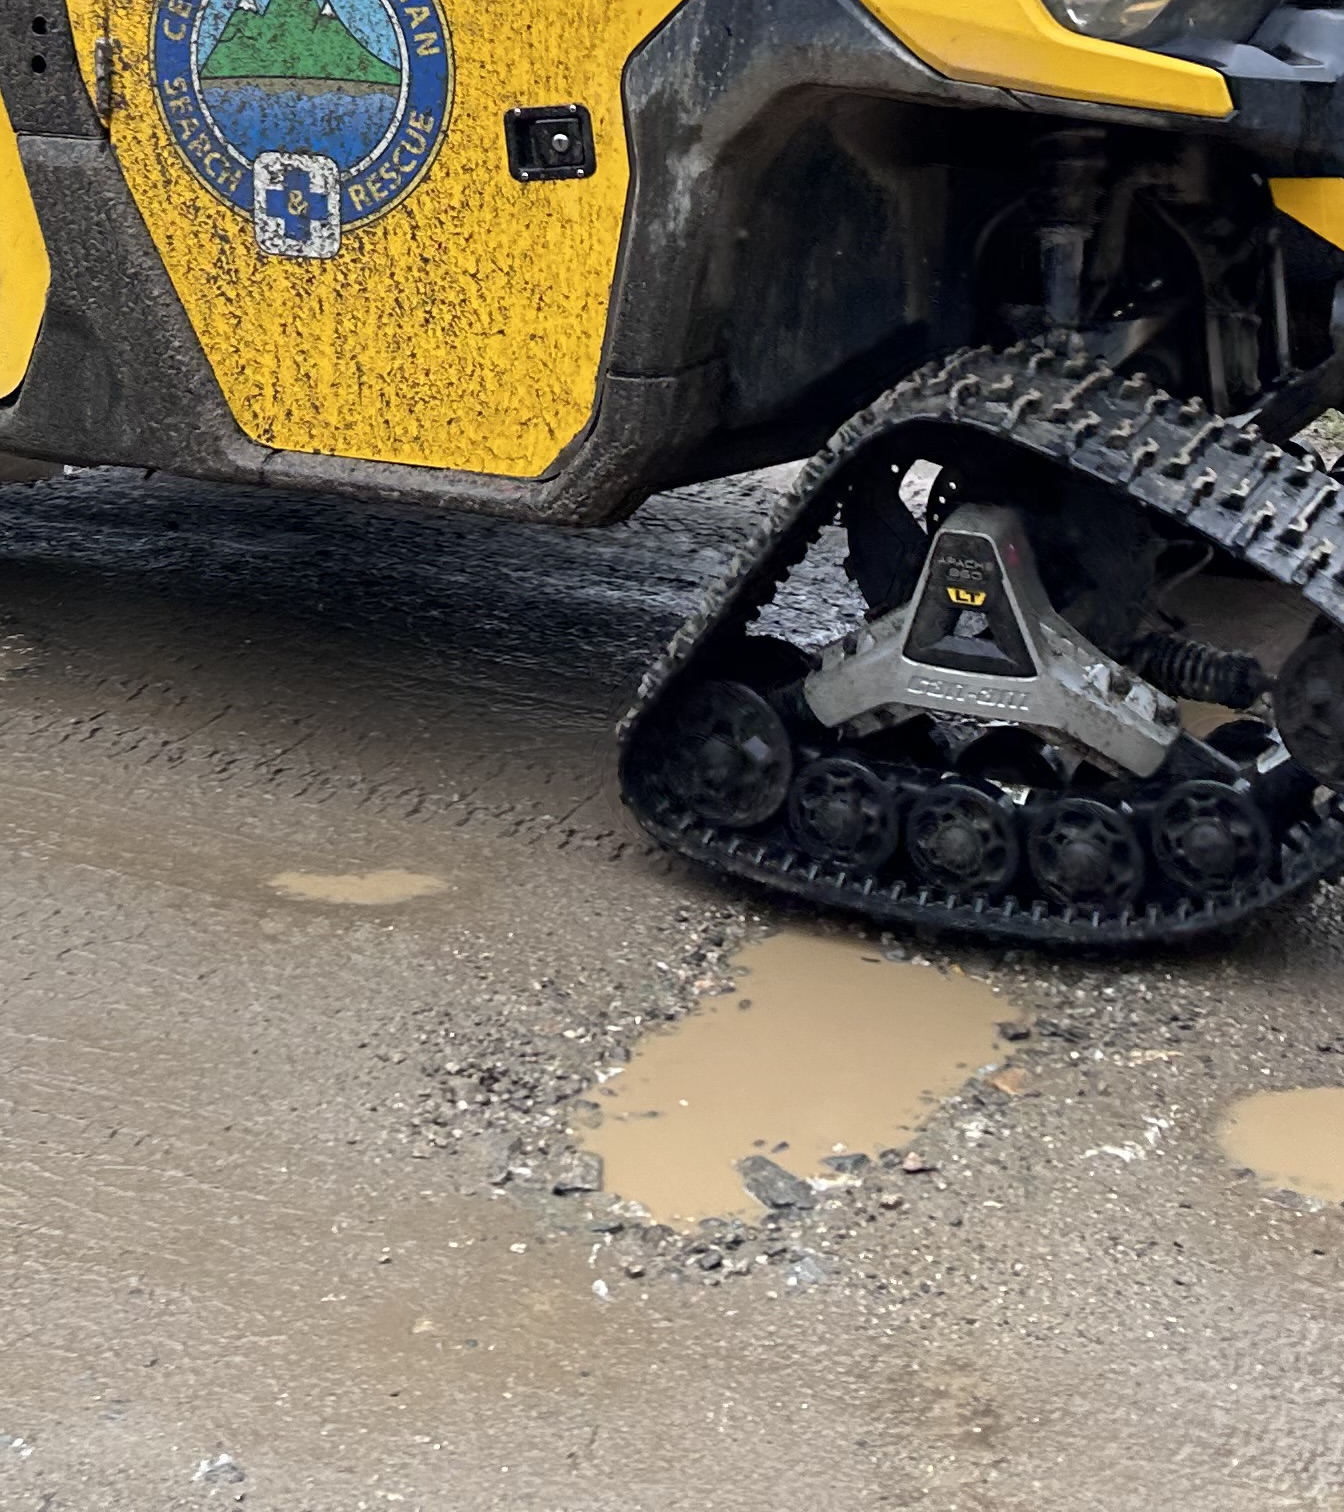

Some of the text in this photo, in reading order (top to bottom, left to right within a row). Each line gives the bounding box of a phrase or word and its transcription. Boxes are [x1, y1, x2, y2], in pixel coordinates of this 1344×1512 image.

[164, 77, 435, 215] SEARCH & RESCUE
